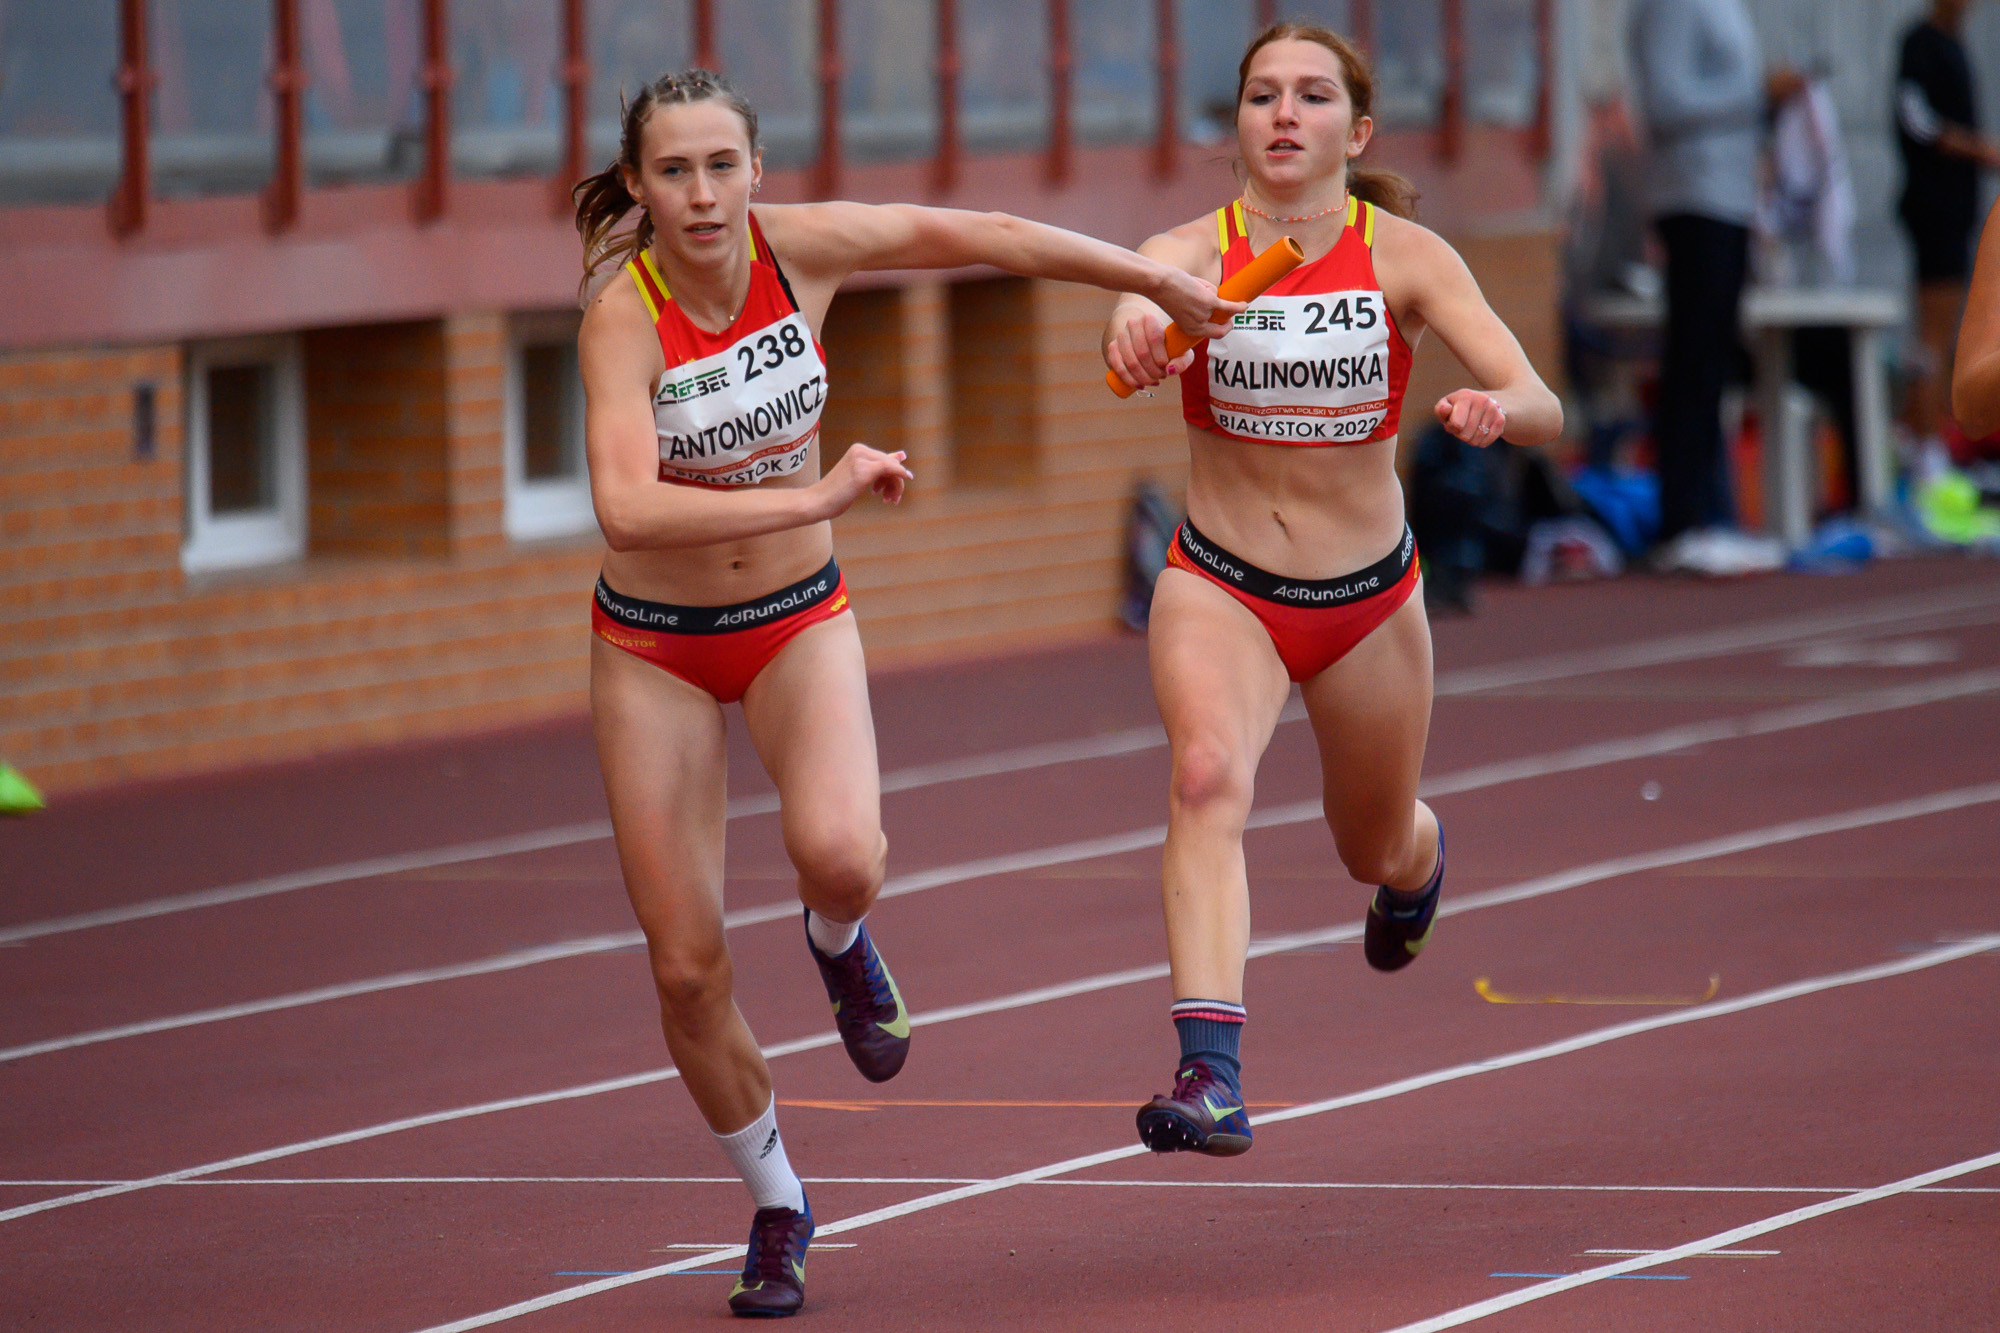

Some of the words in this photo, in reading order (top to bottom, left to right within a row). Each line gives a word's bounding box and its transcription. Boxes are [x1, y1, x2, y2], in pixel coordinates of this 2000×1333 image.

[1303, 297, 1377, 335] 245
[737, 324, 805, 383] 238
[1214, 352, 1384, 390] KALINOWSKA
[669, 375, 823, 460] ANTONOWICZ
[1219, 414, 1327, 438] BIAŁYSTOK
[1333, 417, 1378, 437] 2022
[1296, 407, 1326, 416] POLSKI
[1328, 408, 1336, 416] W
[1337, 402, 1385, 415] SZTAFETACH
[1181, 521, 1244, 581] dRunaLine
[596, 580, 679, 626] dRunaLine
[713, 579, 828, 627] AdRunaLine
[1273, 576, 1380, 600] AdRunaLine
